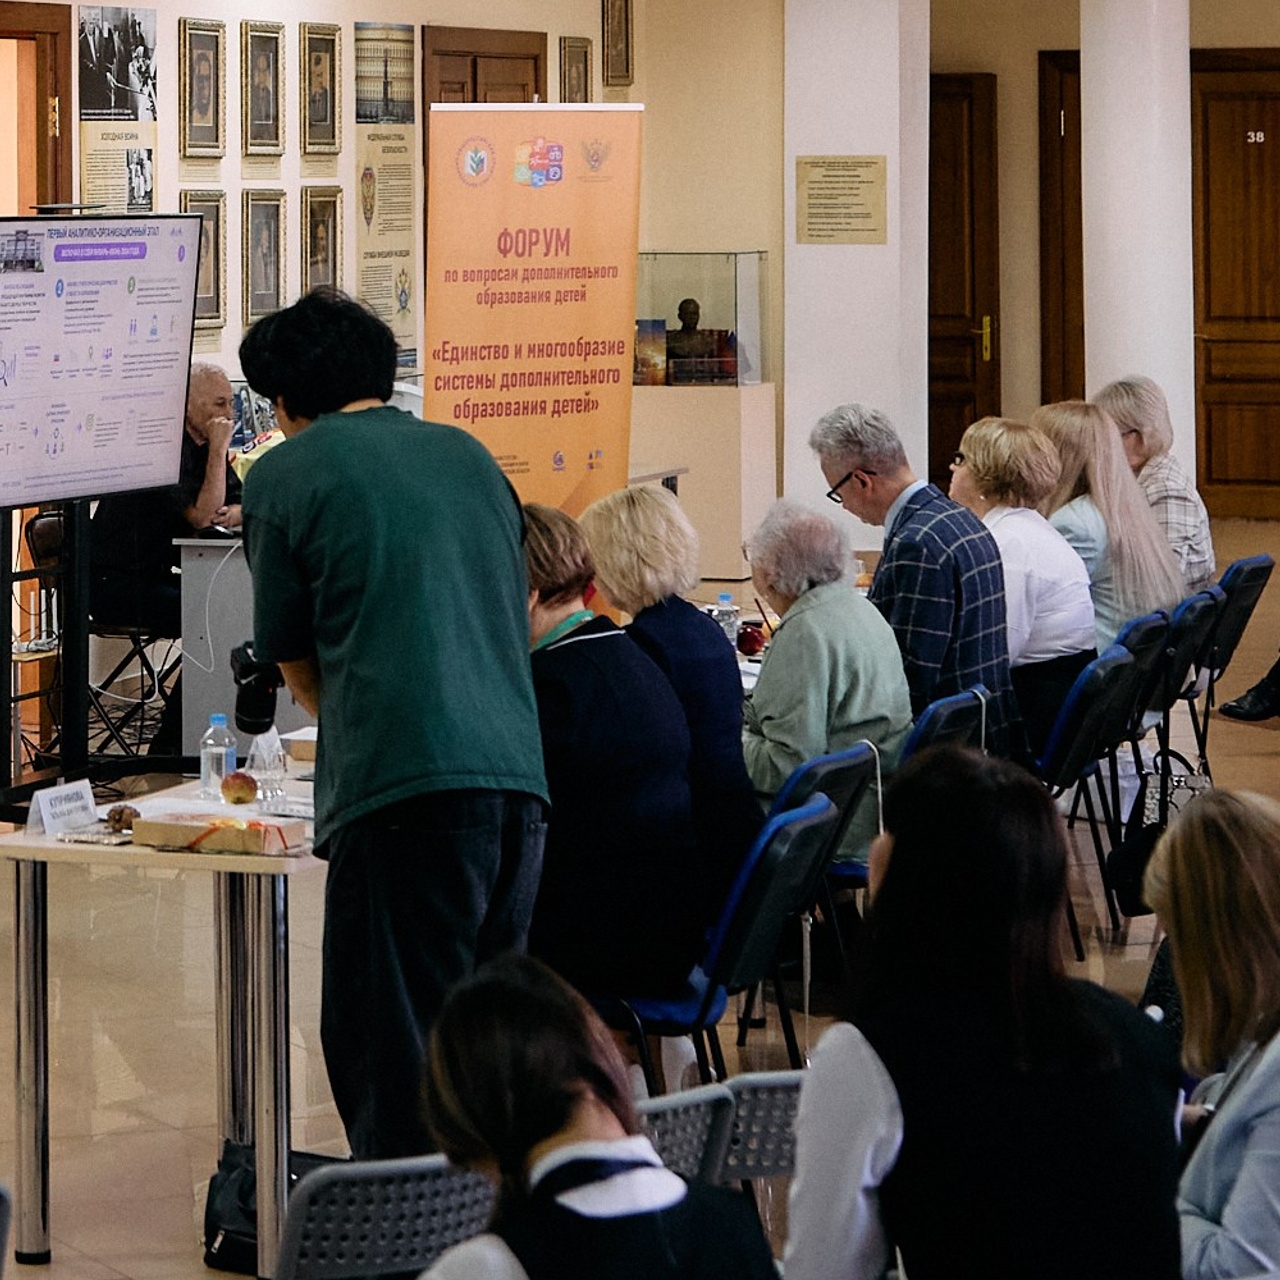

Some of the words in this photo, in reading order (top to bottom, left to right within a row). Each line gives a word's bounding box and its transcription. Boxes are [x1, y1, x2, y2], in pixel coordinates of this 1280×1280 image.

[1247, 131, 1265, 143] 38
[497, 227, 571, 258] ФОРУМ
[444, 269, 459, 283] по
[462, 267, 519, 287] вопросам
[521, 265, 619, 283] дополнительного
[476, 287, 552, 309] образования
[554, 283, 587, 305] детей
[432, 340, 510, 365] «Единство
[514, 343, 523, 360] и
[527, 336, 626, 362] многообразие
[434, 373, 496, 392] системы
[499, 367, 621, 392] дополнительного
[453, 398, 548, 424] образования
[550, 390, 599, 418] детей»
